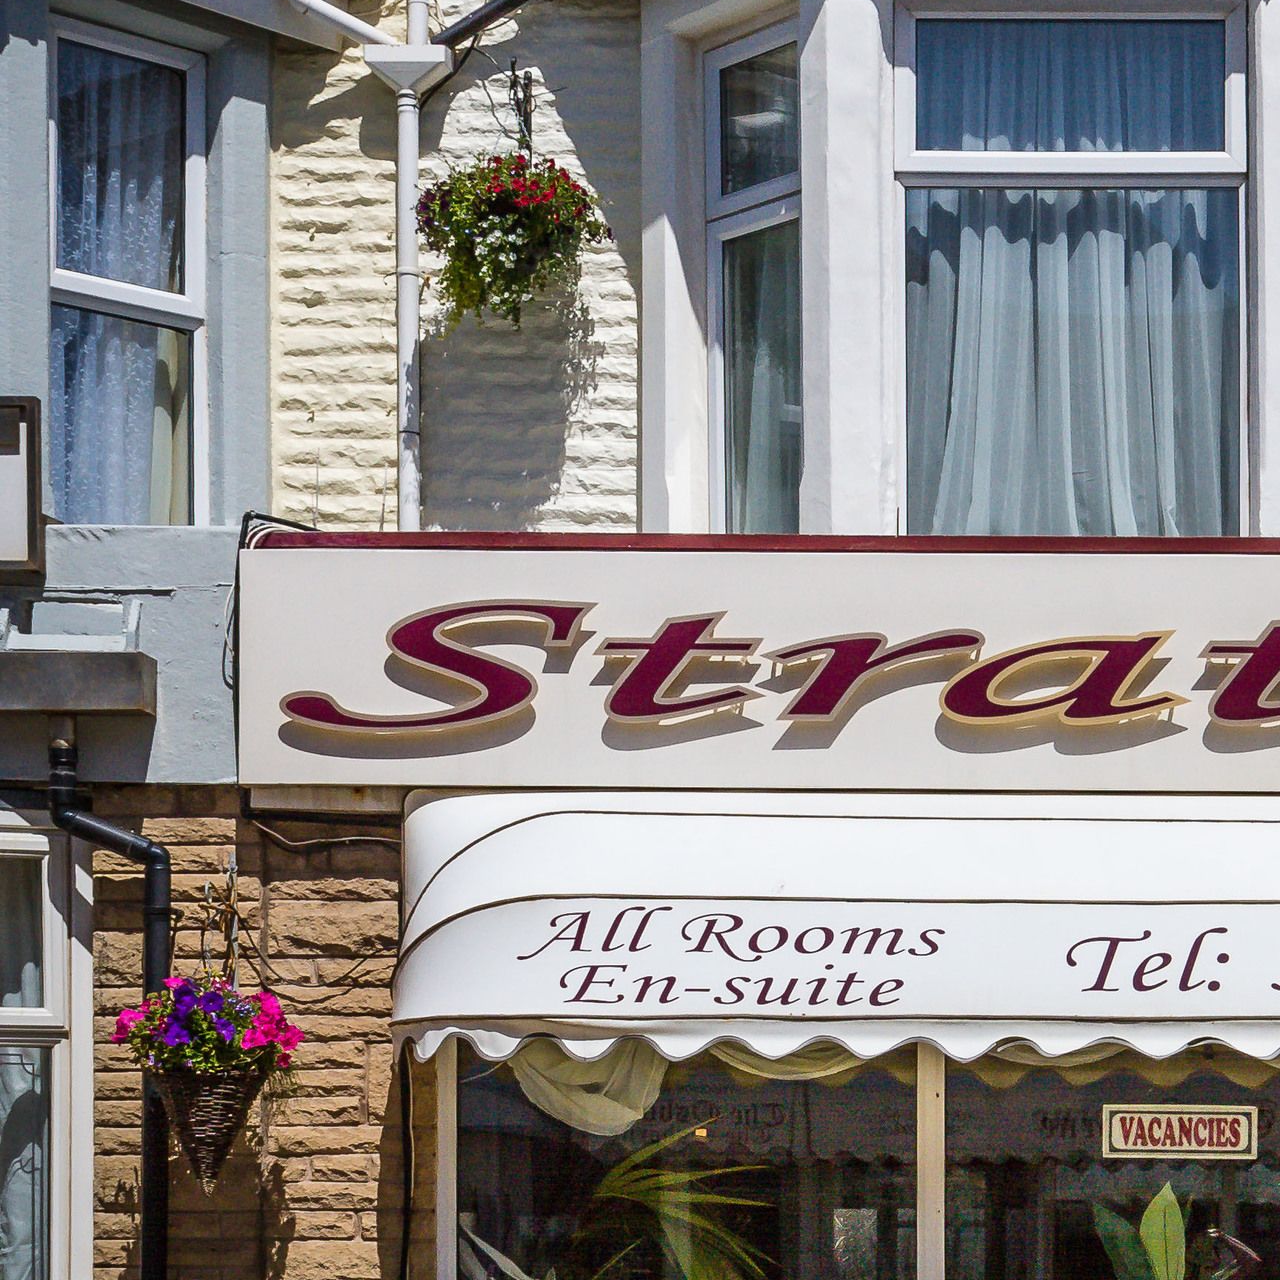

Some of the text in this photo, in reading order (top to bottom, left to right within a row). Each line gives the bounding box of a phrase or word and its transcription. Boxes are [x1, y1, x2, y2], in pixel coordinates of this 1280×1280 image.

[517, 906, 946, 962] All Rooms
[559, 964, 905, 1006] En-suite
[1065, 928, 1232, 993] Tel:
[1119, 1116, 1241, 1148] VACANCIES
